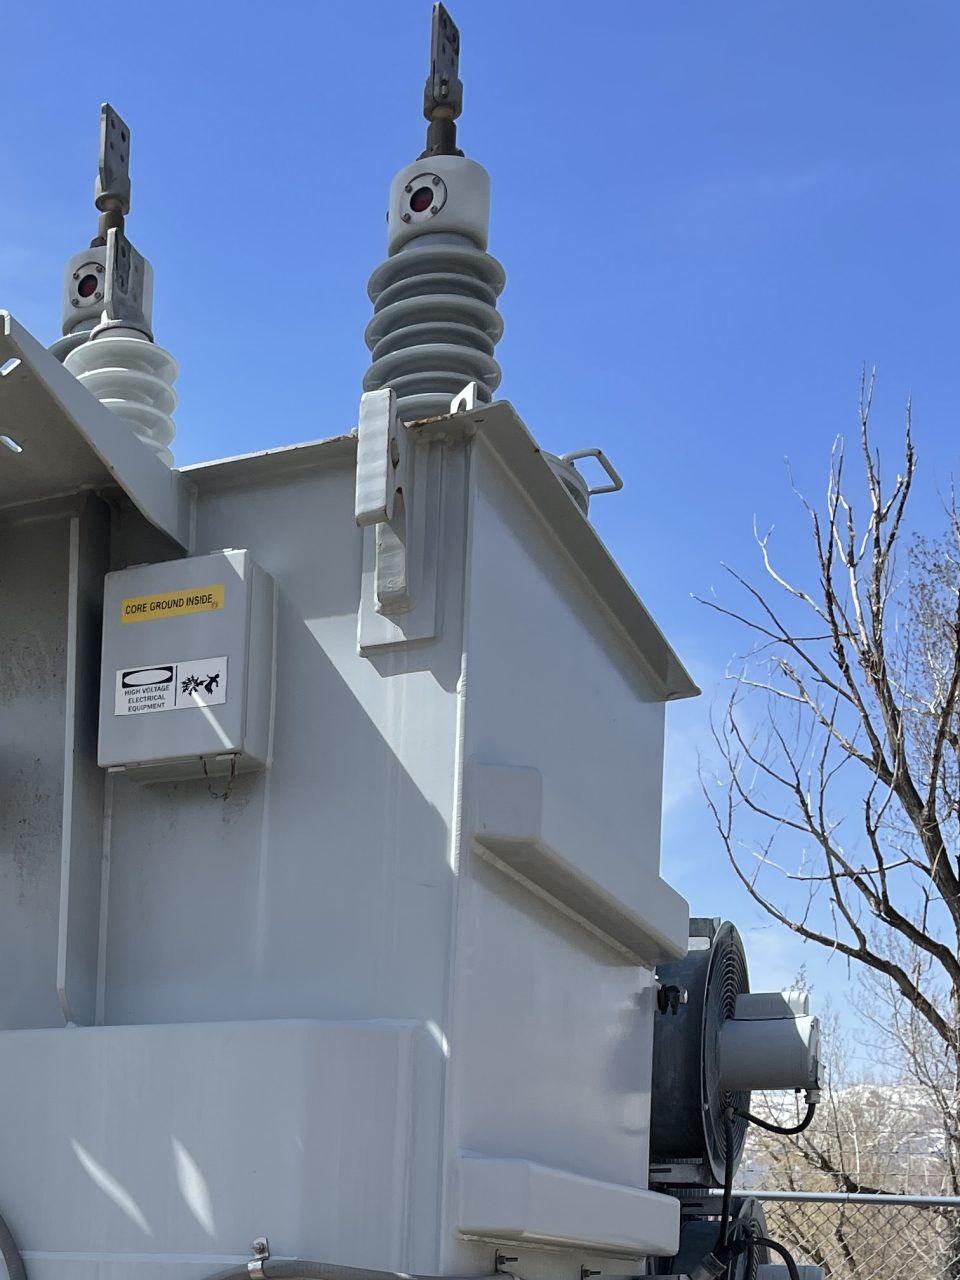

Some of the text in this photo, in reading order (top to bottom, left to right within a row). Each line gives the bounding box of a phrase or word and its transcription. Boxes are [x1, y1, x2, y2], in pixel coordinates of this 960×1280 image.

[125, 594, 213, 615] CORE GROUND INSIDE
[142, 684, 170, 694] VOLTAGE
[128, 694, 166, 704] ELECTRICAL
[128, 702, 166, 712] EQUIPMENT
